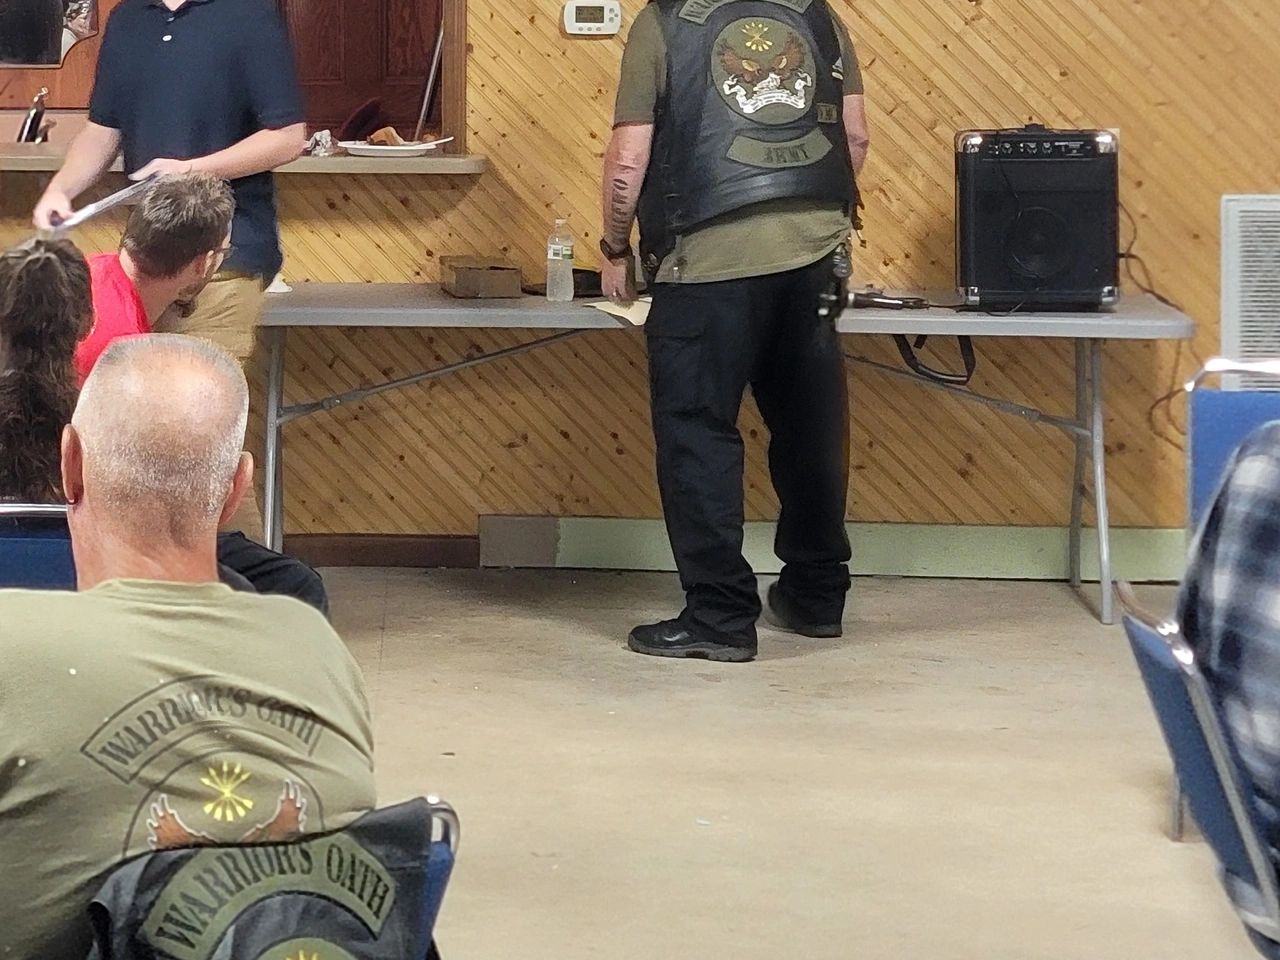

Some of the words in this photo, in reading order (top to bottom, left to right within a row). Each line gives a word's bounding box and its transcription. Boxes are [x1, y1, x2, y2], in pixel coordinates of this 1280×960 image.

[99, 687, 249, 766] WARRIOR'S
[257, 696, 314, 745] OATH
[155, 841, 314, 949] WARRIOR'S
[326, 843, 390, 919] OATH
